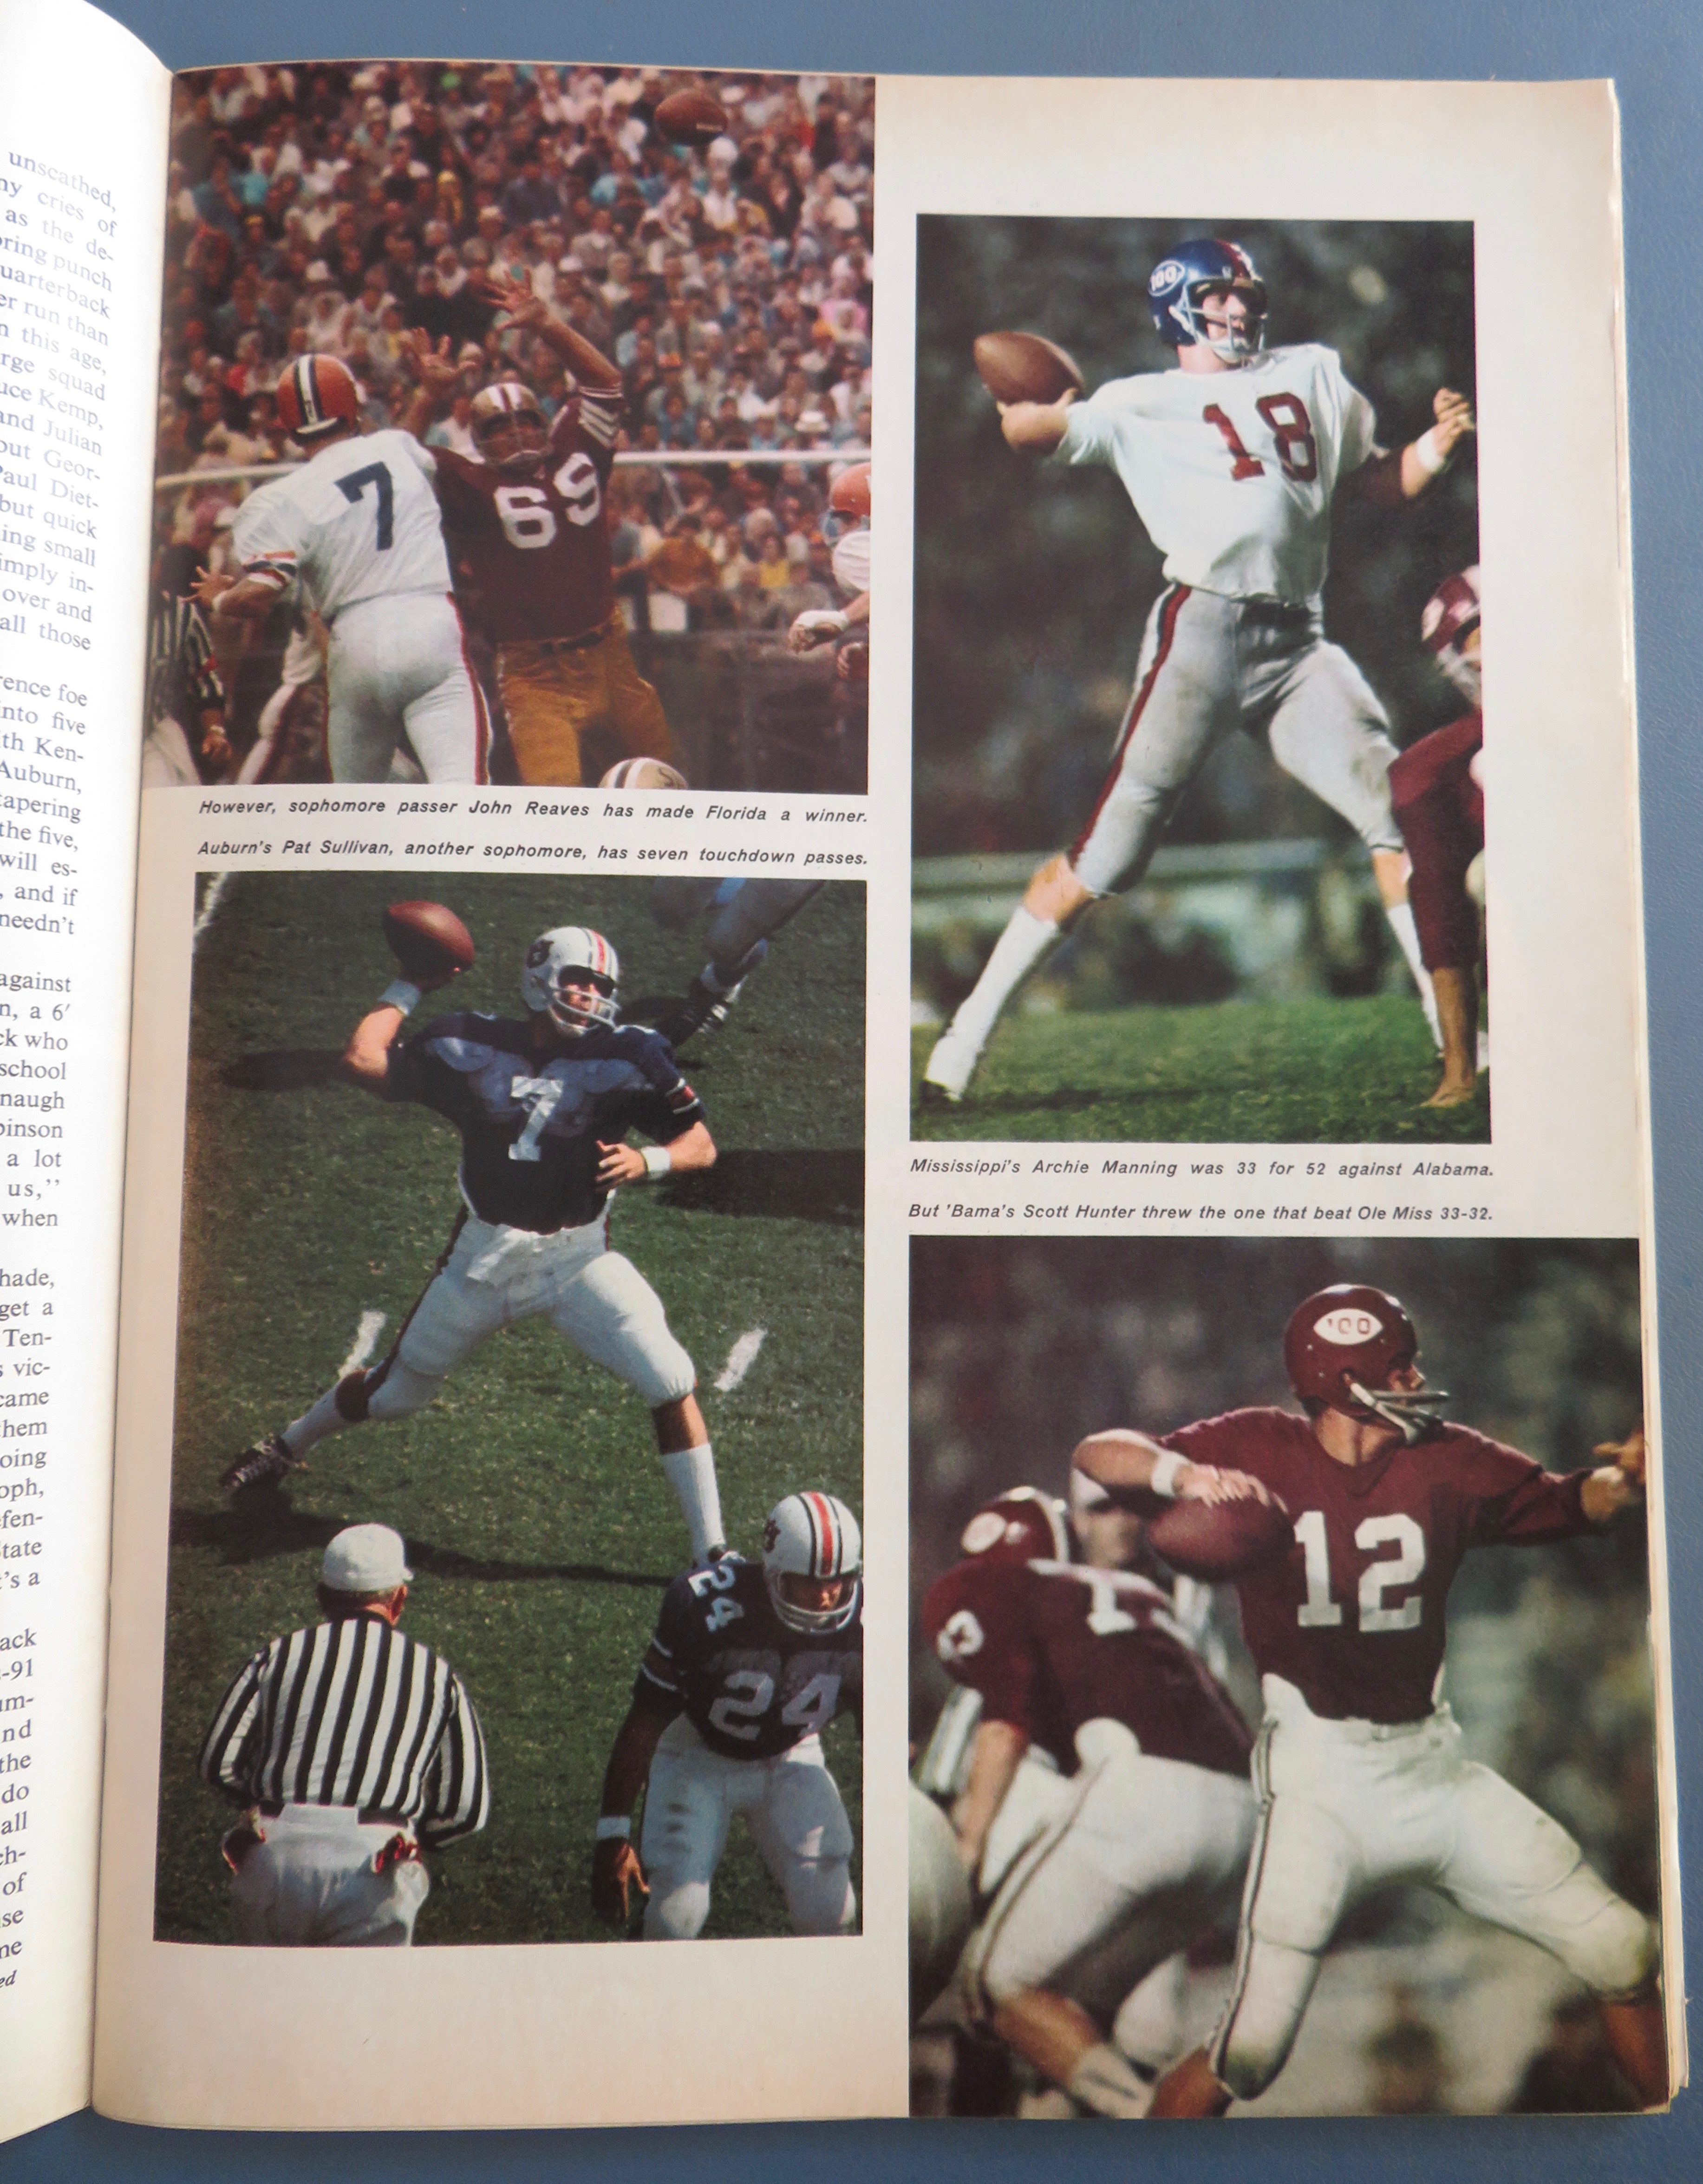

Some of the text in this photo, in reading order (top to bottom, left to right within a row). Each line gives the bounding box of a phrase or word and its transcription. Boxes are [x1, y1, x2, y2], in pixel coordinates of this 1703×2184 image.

[8, 152, 116, 213] unscathed,
[38, 193, 84, 220] cries
[98, 219, 117, 237] of
[5, 209, 113, 261] as the de-
[0, 235, 111, 292] ring punch
[24, 302, 59, 324] run
[68, 316, 108, 346] than
[22, 328, 59, 353] this
[70, 348, 106, 375] age,
[49, 368, 105, 401] squad
[39, 389, 103, 431] Kemp,
[43, 420, 102, 456] Julian
[1202, 391, 1317, 482] 18
[44, 450, 100, 480] Geor-
[0, 465, 98, 508] aul Diet-
[334, 461, 393, 551] 7
[494, 452, 600, 549] 69
[0, 493, 97, 539] but quick
[44, 540, 95, 567] small
[69, 571, 94, 593] in-
[2, 589, 92, 622] over and
[0, 615, 91, 650] all those
[0, 675, 88, 707] ence foe
[52, 712, 86, 735] five
[33, 737, 84, 762] Ken-
[0, 759, 81, 795] Auburn,
[0, 794, 81, 824] apering
[199, 799, 867, 822] However, sophomore passer John Reaves has made Florida a winner.
[38, 825, 78, 852] five,
[0, 851, 78, 876] will es-
[197, 840, 867, 866] Auburn's Pat Sullivan, another sophomore, has seven touchdown passes.
[14, 885, 54, 903] and
[62, 888, 78, 906] if
[0, 914, 74, 935] needn't
[0, 972, 71, 993] against
[29, 1006, 42, 1020] a
[24, 1031, 68, 1051] who
[0, 1059, 66, 1080] school
[508, 1076, 564, 1162] 7
[7, 1149, 62, 1168] a lot
[910, 1159, 1493, 1178] Mississippi's Archie Manning was 33 for 52 against Alabama.
[1, 1208, 59, 1227] when
[908, 1204, 1492, 1220] But 'Bama's Scott Hunter threw the one that beat Ole Miss 33-32.
[0, 1301, 54, 1322] get a
[2, 1328, 52, 1347] Ten-
[13, 1357, 51, 1376] vic-
[0, 1419, 48, 1438] hem
[0, 1509, 44, 1529] fen-
[0, 1540, 43, 1559] tate
[28, 1572, 41, 1586] a
[1294, 1510, 1426, 1633] 12
[687, 1564, 744, 1633] 24
[708, 1670, 842, 1741] 24
[1, 1783, 30, 1804] do
[0, 1810, 28, 1835] all
[2, 1870, 28, 1896] of
